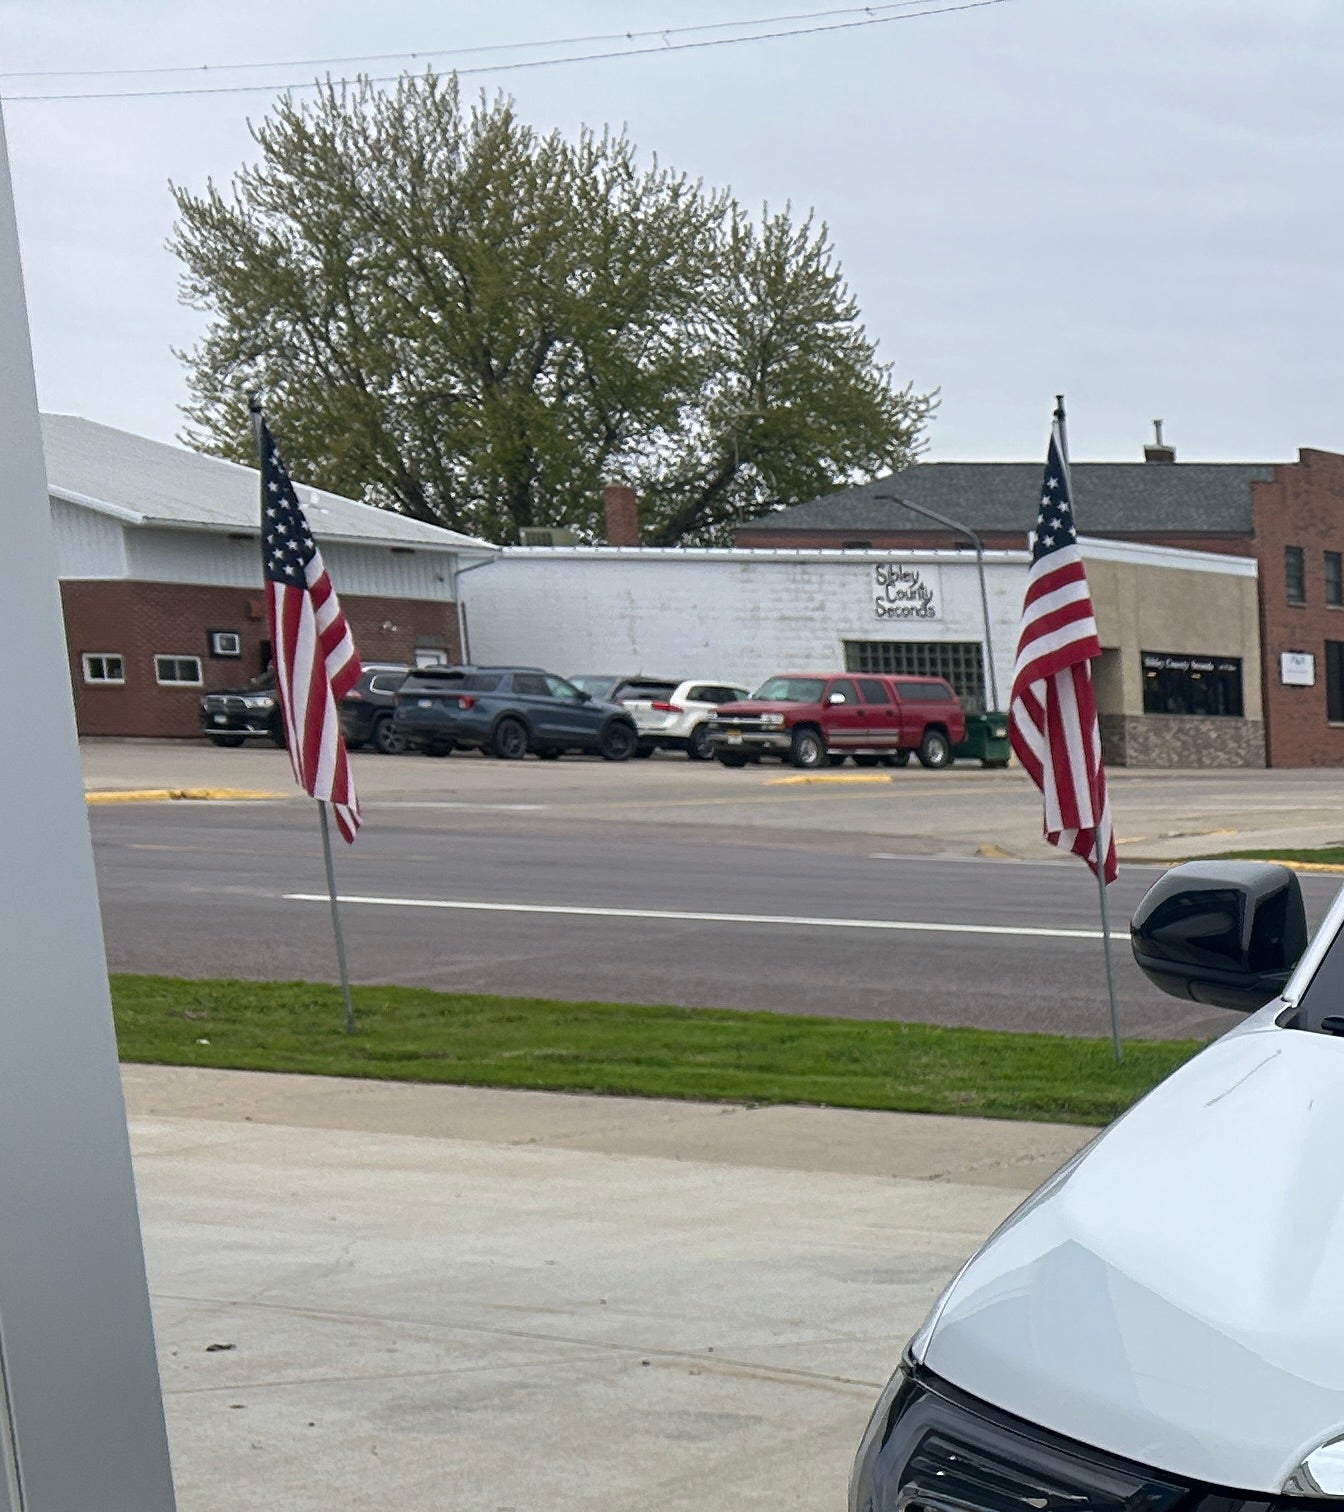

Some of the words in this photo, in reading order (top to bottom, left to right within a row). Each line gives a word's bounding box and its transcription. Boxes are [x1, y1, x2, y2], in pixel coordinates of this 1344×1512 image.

[876, 563, 920, 589] Sibley
[885, 581, 934, 604] County
[875, 596, 936, 618] Seconds
